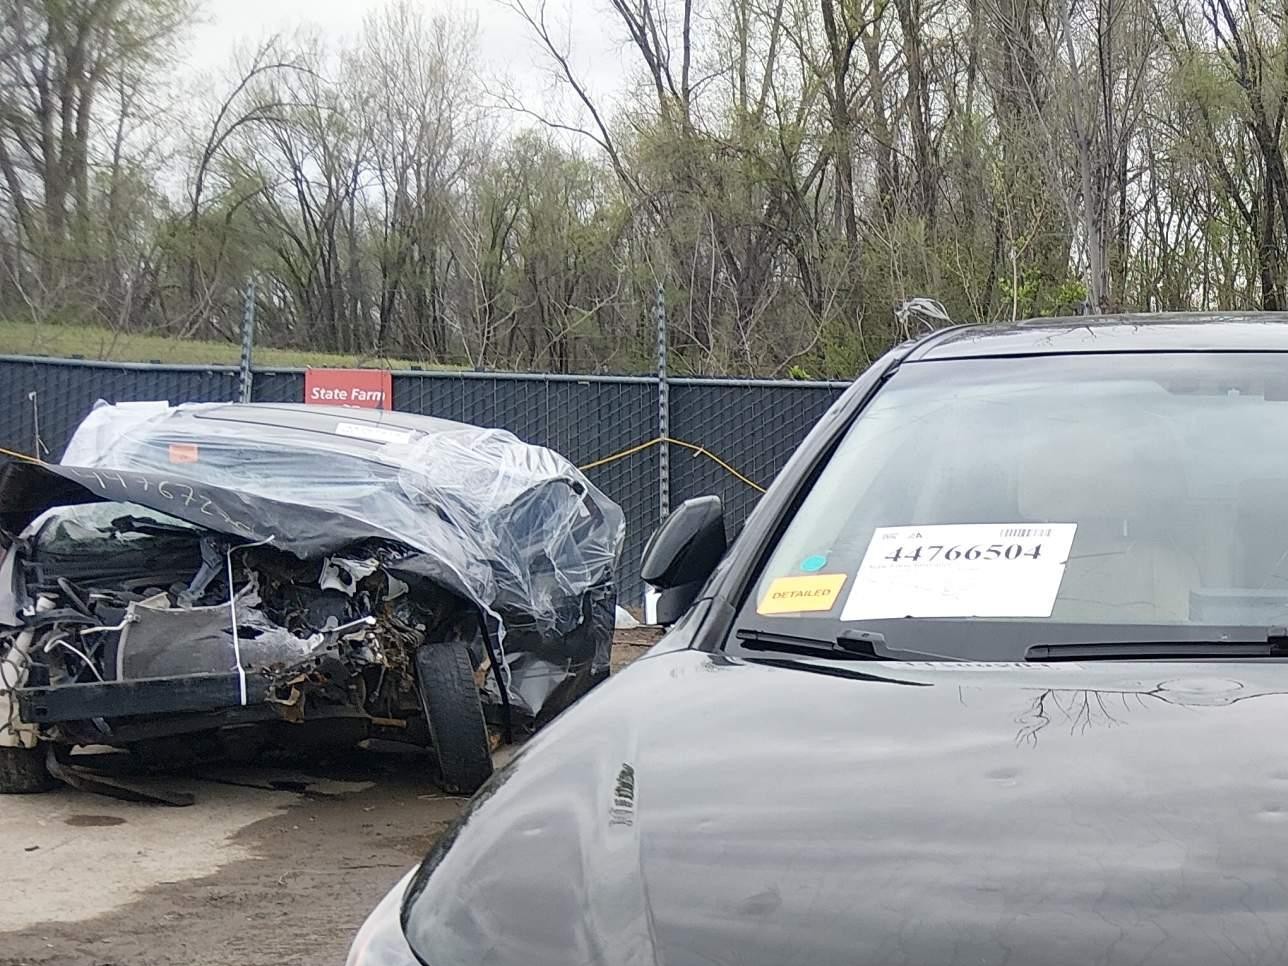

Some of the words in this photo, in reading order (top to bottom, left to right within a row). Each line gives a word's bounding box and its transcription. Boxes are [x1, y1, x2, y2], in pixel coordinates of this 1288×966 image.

[311, 387, 347, 400] State
[352, 388, 386, 401] Farm
[884, 543, 1041, 562] 44766504
[771, 588, 832, 600] DETAILED
